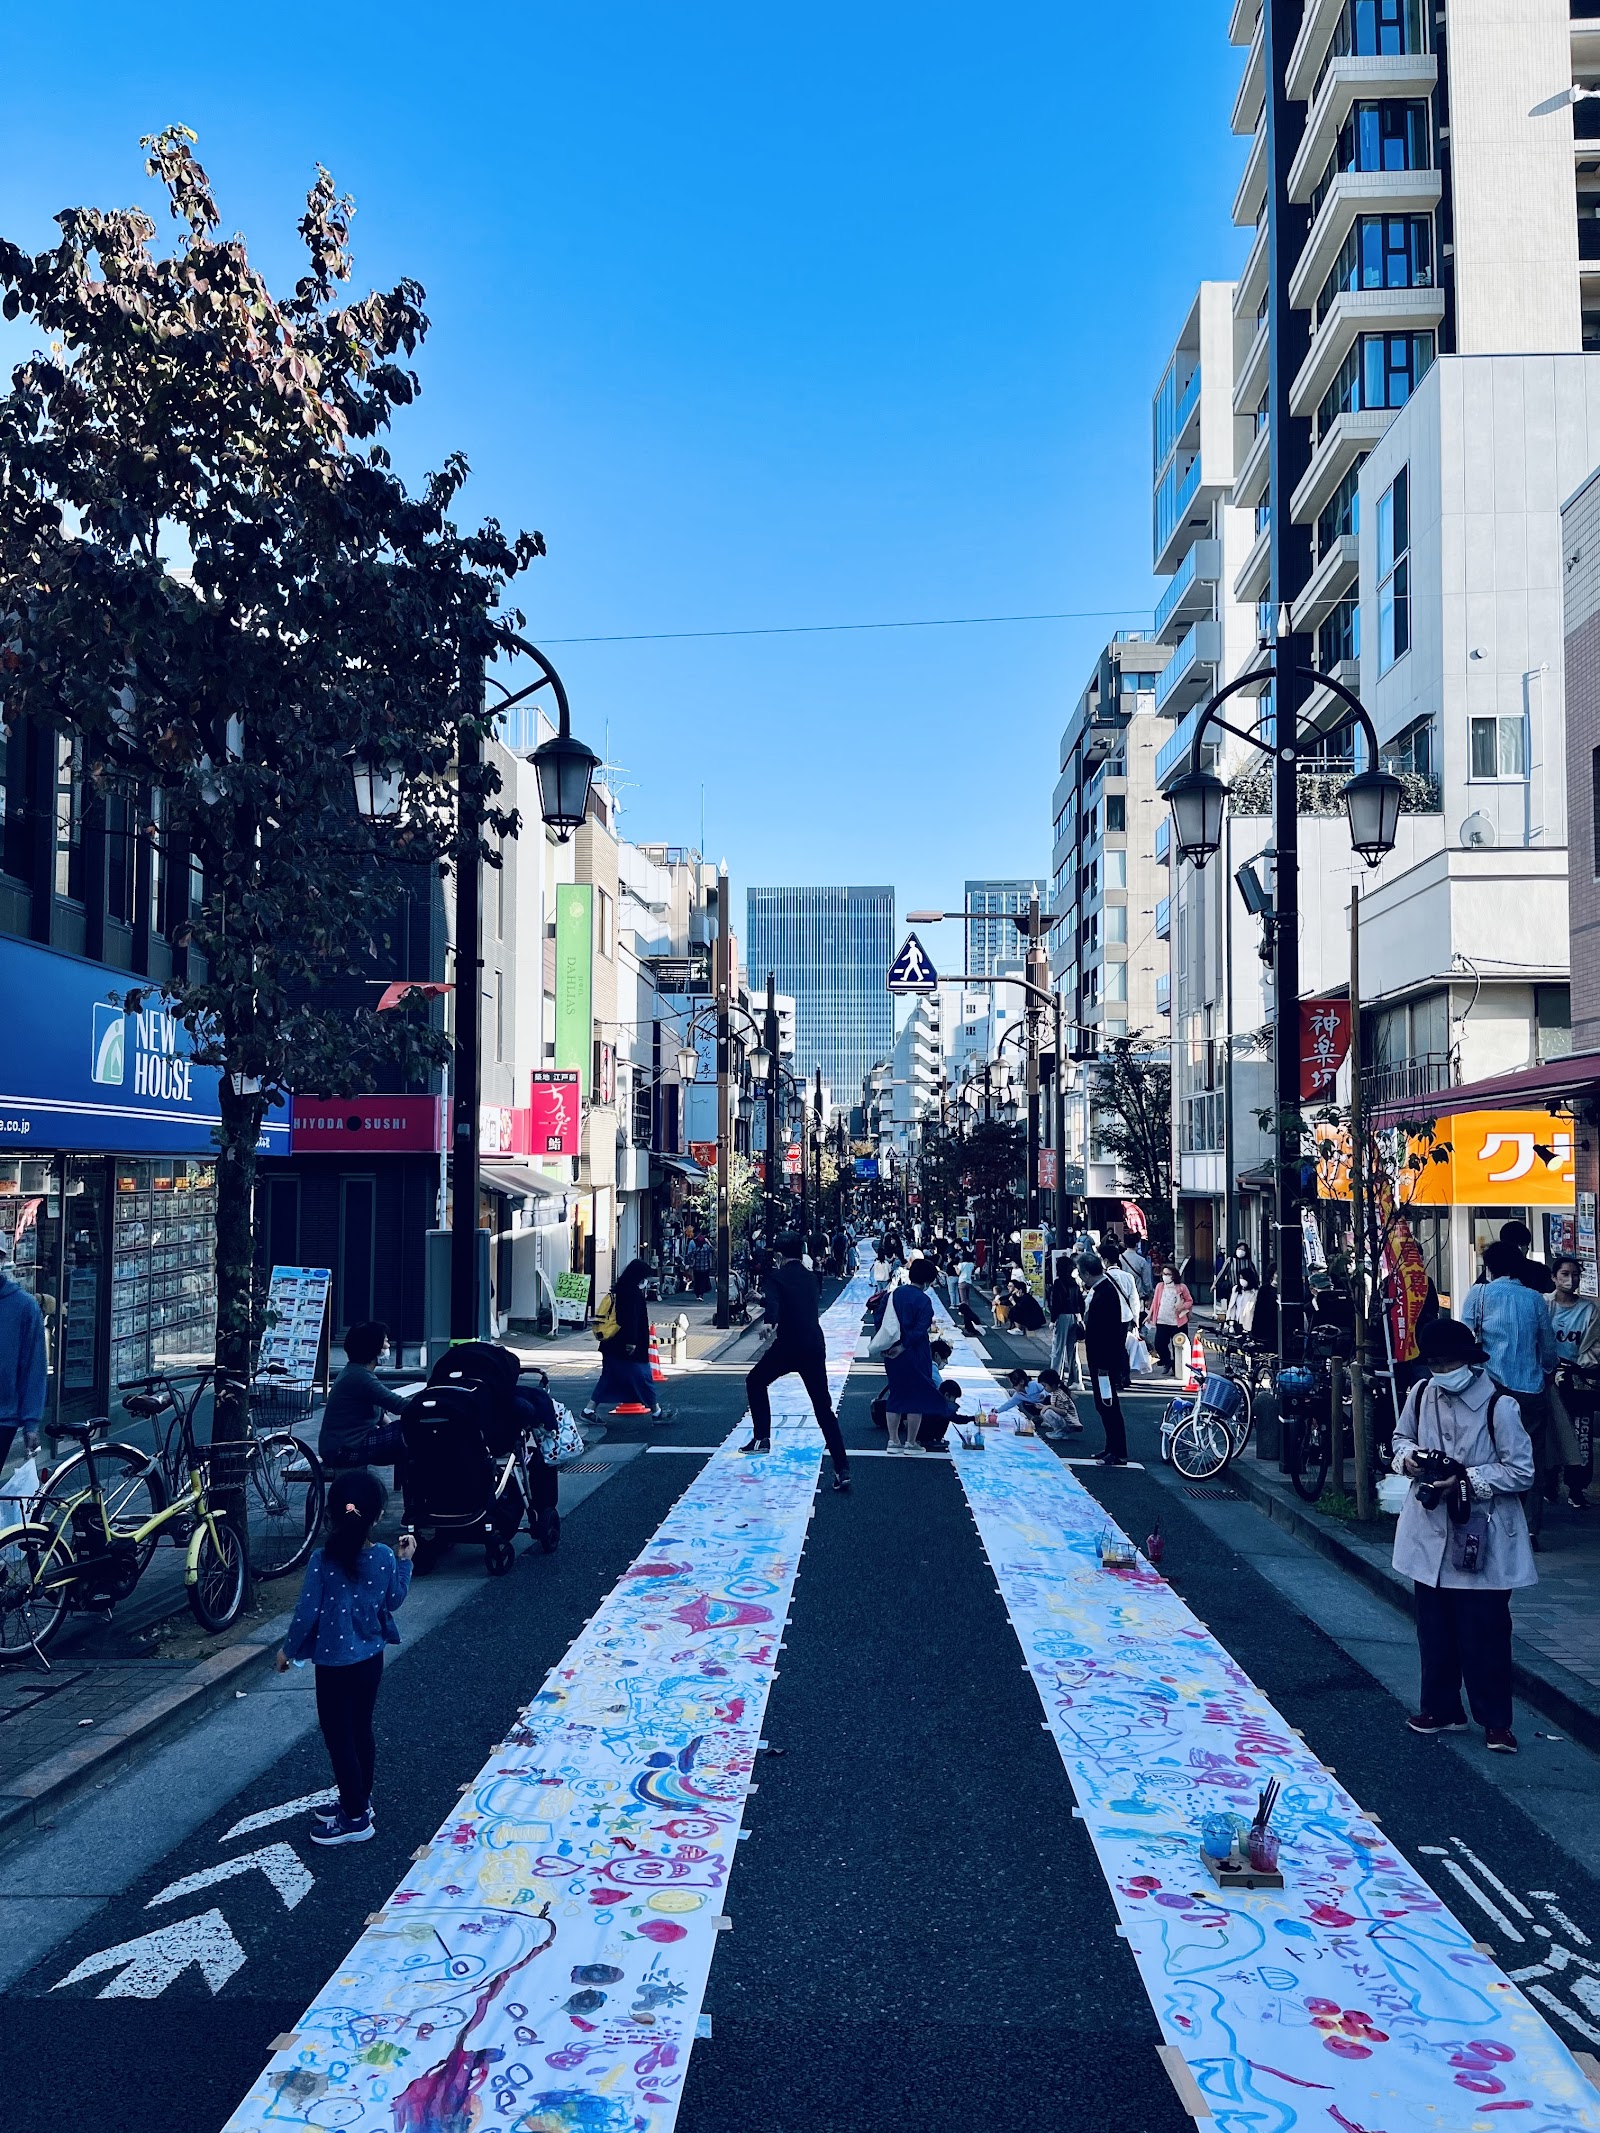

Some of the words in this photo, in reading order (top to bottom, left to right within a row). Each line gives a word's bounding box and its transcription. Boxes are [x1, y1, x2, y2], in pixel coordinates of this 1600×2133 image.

[566, 957, 576, 1015] DAHLIAS
[136, 1009, 177, 1055] NEW
[134, 1052, 194, 1102] HOUSE
[534, 1073, 551, 1082] 築地
[553, 1073, 577, 1082] 江戸前
[365, 1117, 407, 1130] SUSHI
[548, 1137, 562, 1151] 鮨
